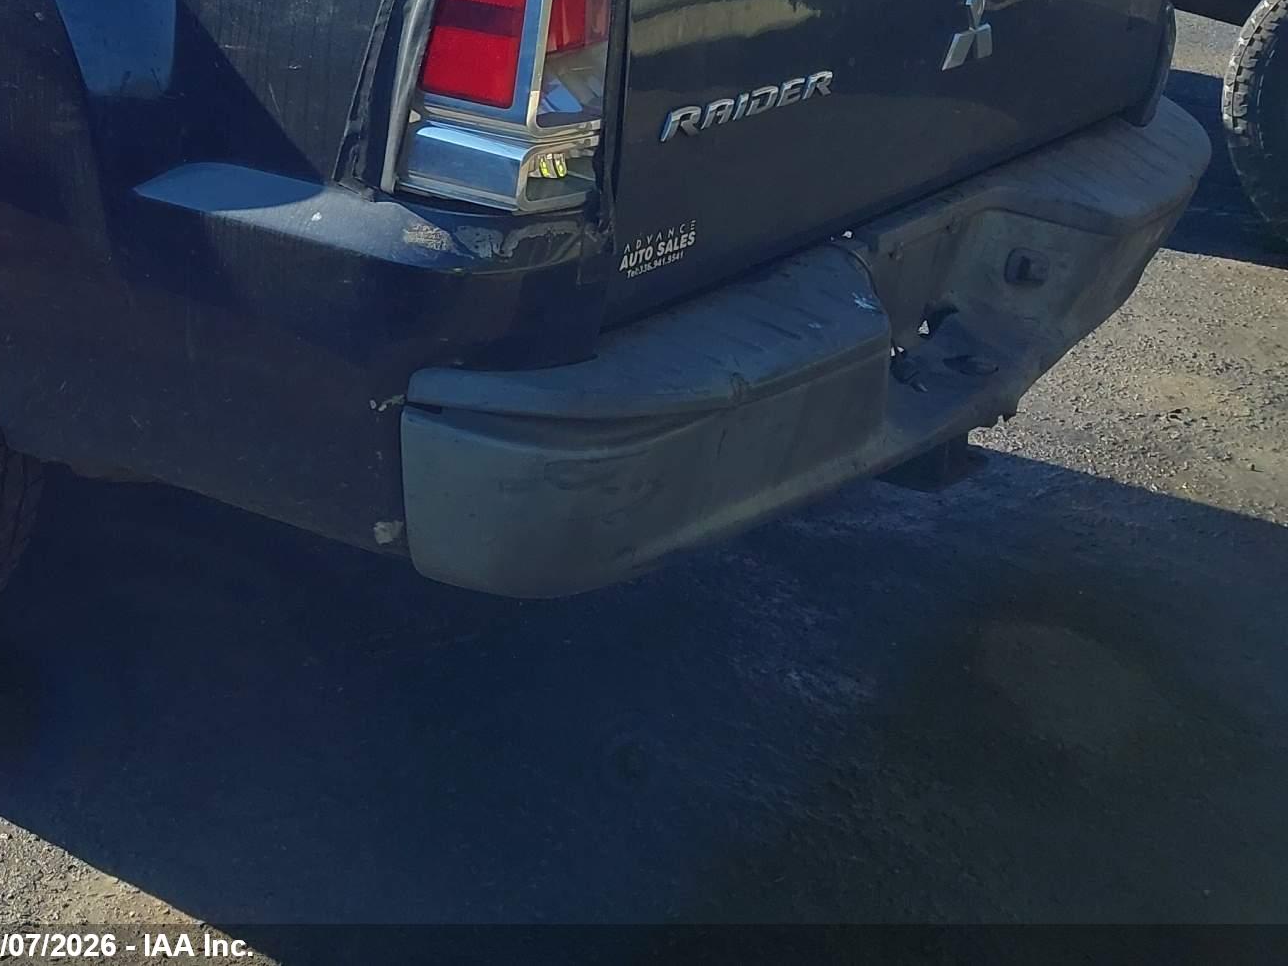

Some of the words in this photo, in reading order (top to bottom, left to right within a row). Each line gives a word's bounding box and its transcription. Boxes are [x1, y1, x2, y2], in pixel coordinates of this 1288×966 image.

[660, 70, 834, 142] RAIDER
[619, 246, 653, 271] AUTO
[656, 231, 696, 257] SALES
[623, 220, 696, 254] ADVANCE
